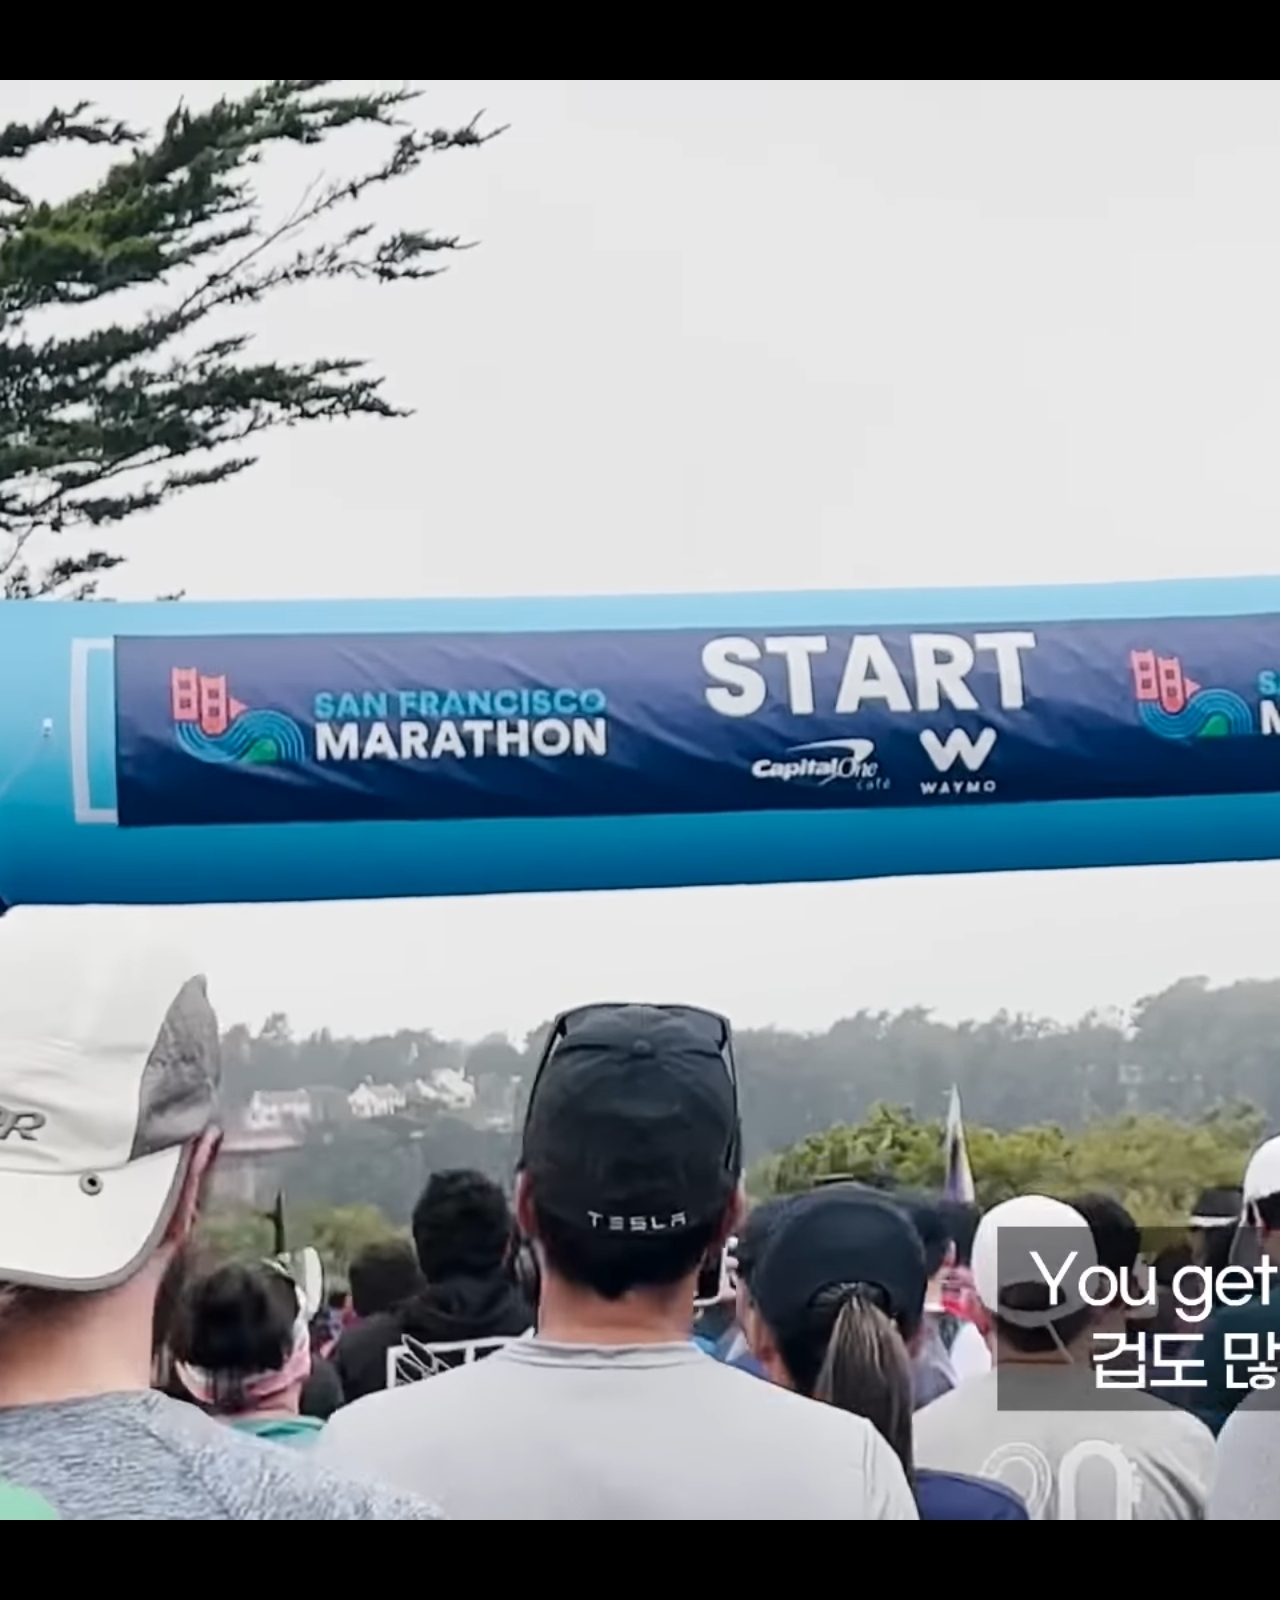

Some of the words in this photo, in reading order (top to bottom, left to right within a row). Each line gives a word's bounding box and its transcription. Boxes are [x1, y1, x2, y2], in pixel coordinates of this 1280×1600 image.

[702, 631, 1037, 718] START
[314, 690, 388, 719] SAN
[400, 687, 607, 717] FRANCISCO
[314, 717, 608, 761] MARATHON
[919, 779, 997, 795] WAYMO
[586, 1210, 687, 1232] TESLA
